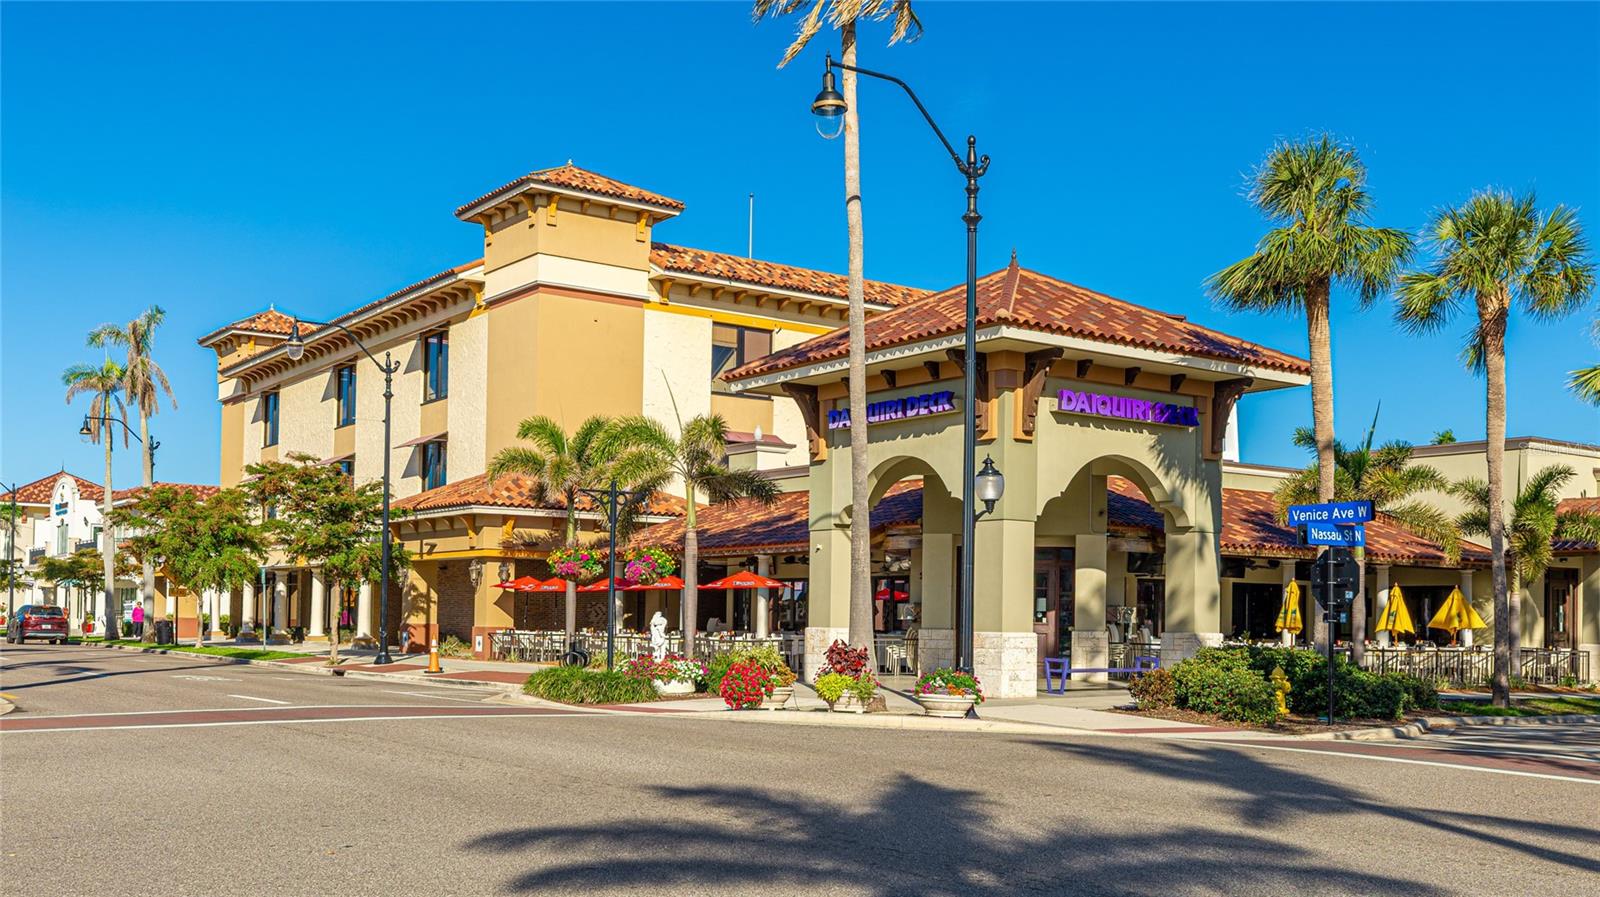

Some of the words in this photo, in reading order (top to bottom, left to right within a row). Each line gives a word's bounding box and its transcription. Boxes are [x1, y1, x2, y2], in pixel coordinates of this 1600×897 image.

[829, 400, 904, 429] DAUIRI
[906, 391, 955, 417] DECK
[1058, 389, 1151, 422] DAIQUIRI
[1292, 509, 1328, 521] Venice
[1332, 507, 1354, 519] Ave
[1357, 506, 1367, 518] W
[1311, 528, 1342, 541] Nassau
[1344, 530, 1353, 541] St
[1355, 530, 1362, 542] N
